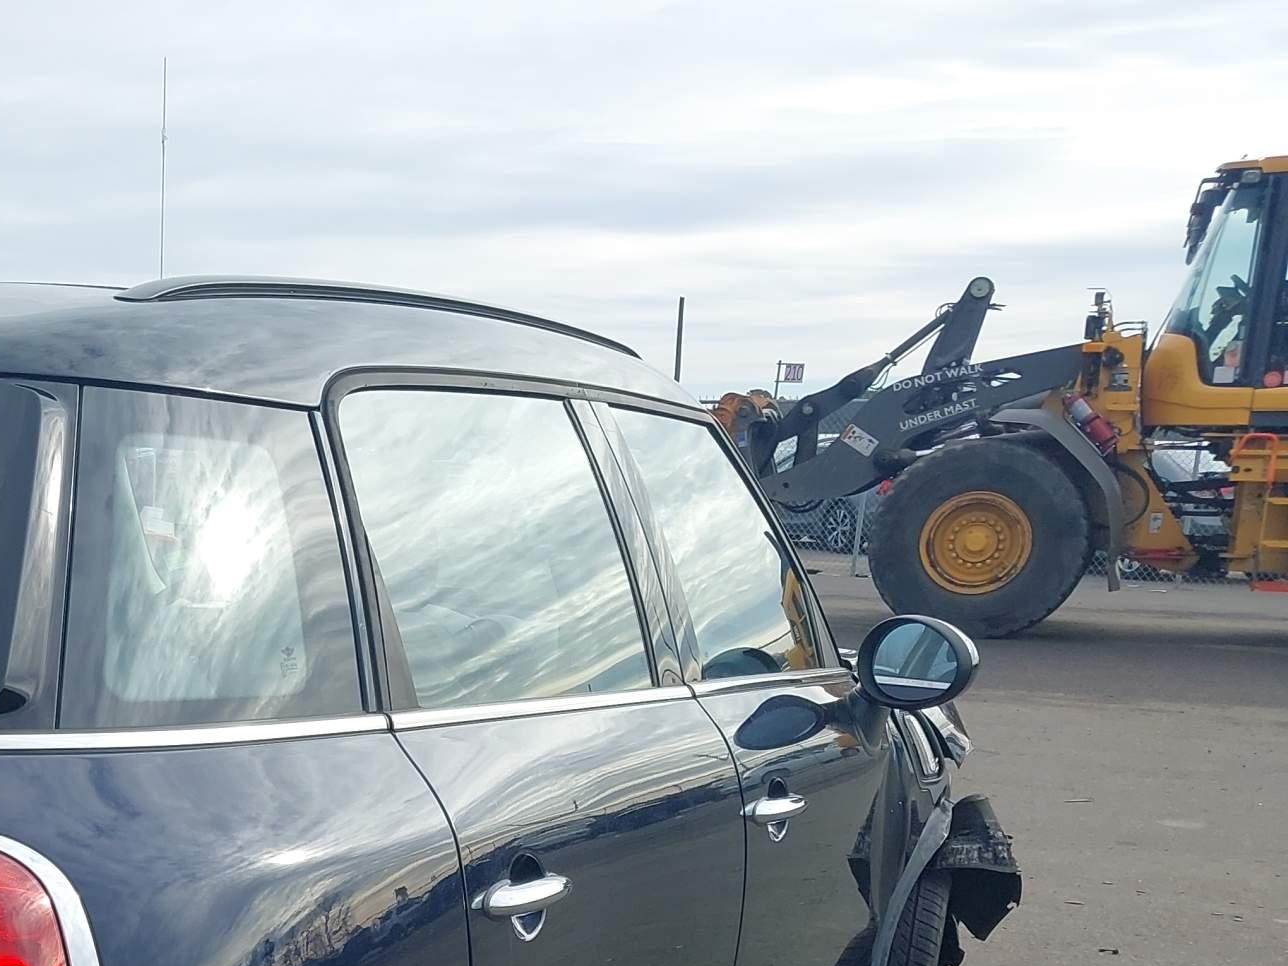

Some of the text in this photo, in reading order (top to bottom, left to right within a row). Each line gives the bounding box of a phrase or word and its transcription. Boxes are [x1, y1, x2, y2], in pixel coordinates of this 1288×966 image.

[893, 364, 984, 392] DO NOT WALK
[899, 398, 977, 431] UNDER MAST
